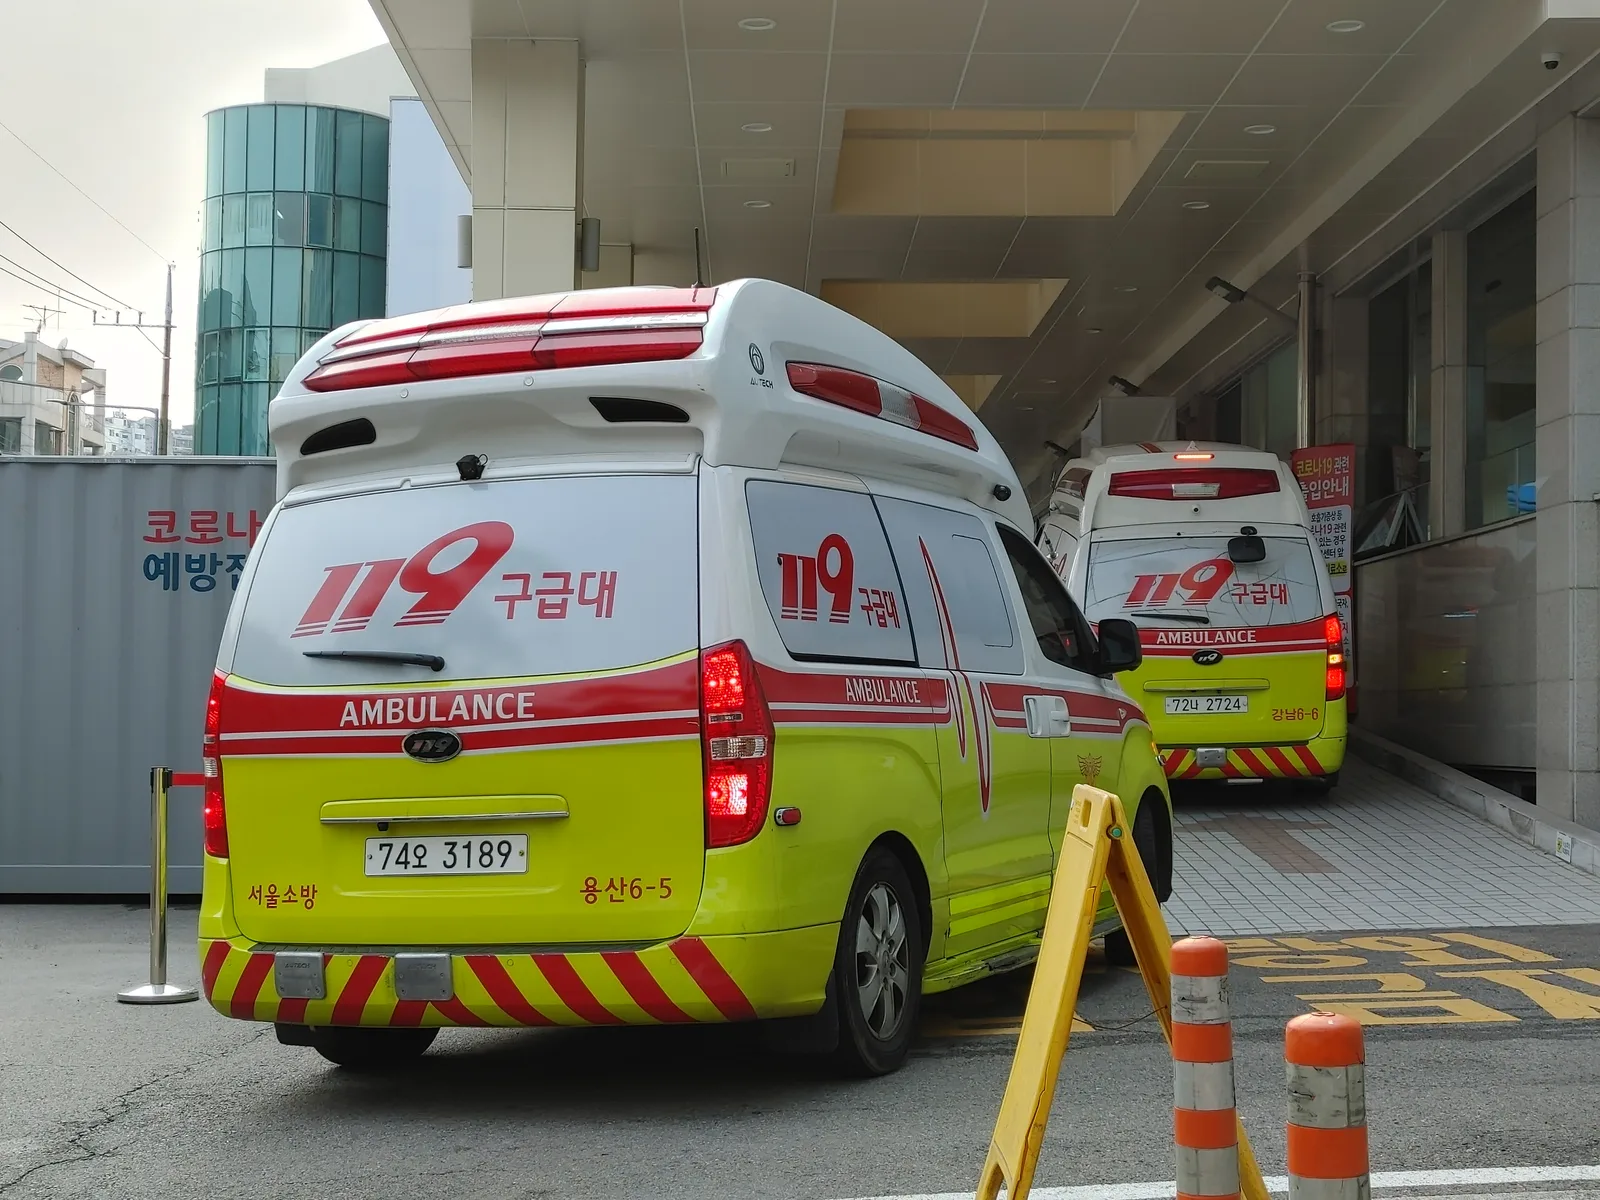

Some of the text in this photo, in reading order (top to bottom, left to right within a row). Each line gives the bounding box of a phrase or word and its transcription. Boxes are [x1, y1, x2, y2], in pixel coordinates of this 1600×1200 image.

[1333, 455, 1349, 475] 관련
[290, 520, 618, 639] 119 구급대
[777, 533, 901, 629] 119 구급대
[1122, 558, 1288, 608] 119 구급대
[1156, 630, 1257, 645] AMBULANCE
[1198, 651, 1218, 662] 119
[845, 677, 921, 704] AMBULANCE
[339, 691, 536, 727] AMBULANCE
[1172, 697, 1241, 711] 72나 2724
[1272, 707, 1319, 721] 강남6-6
[411, 738, 449, 753] 119
[379, 840, 512, 870] 74오 3189
[248, 884, 318, 910] 서울소방
[579, 876, 672, 904] 용산6-5
